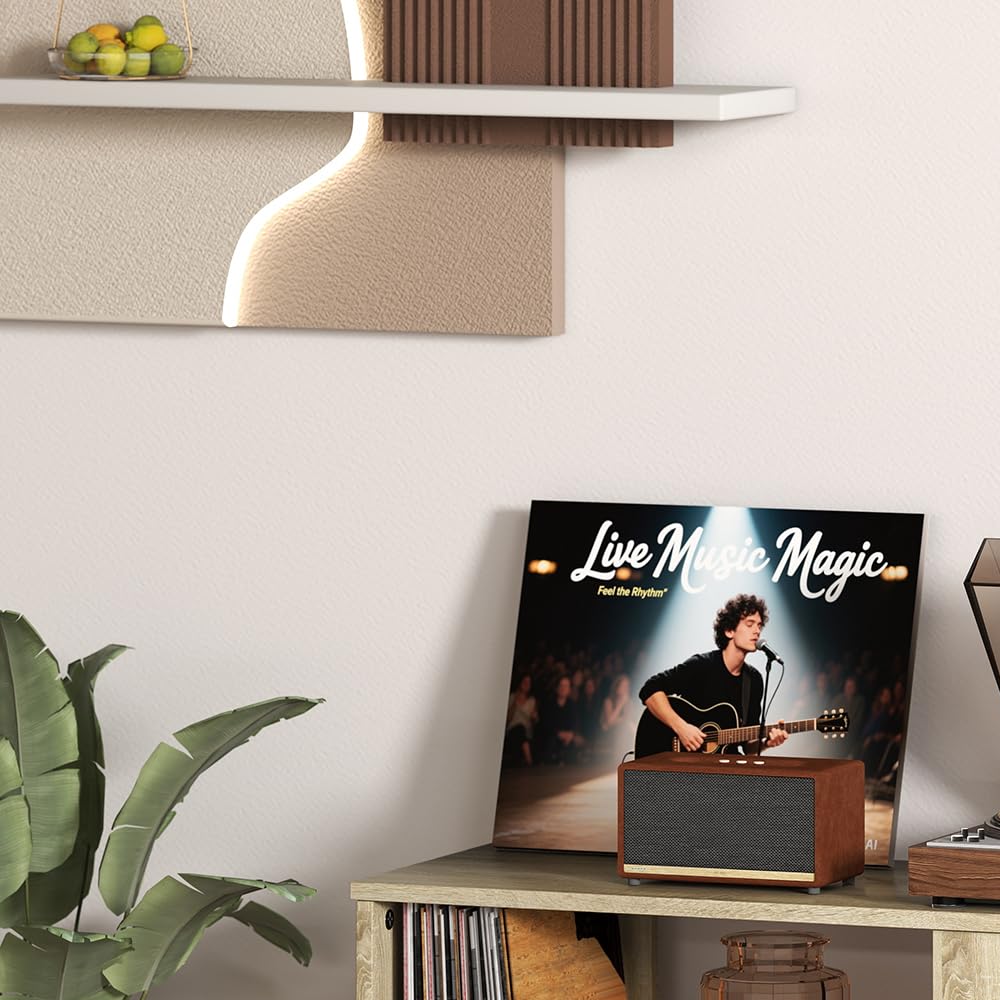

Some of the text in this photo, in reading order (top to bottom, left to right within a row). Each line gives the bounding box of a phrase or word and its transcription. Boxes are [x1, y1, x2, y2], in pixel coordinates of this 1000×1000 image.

[570, 520, 888, 603] Live Music Magic
[597, 585, 616, 596] Feel
[616, 586, 630, 597] the
